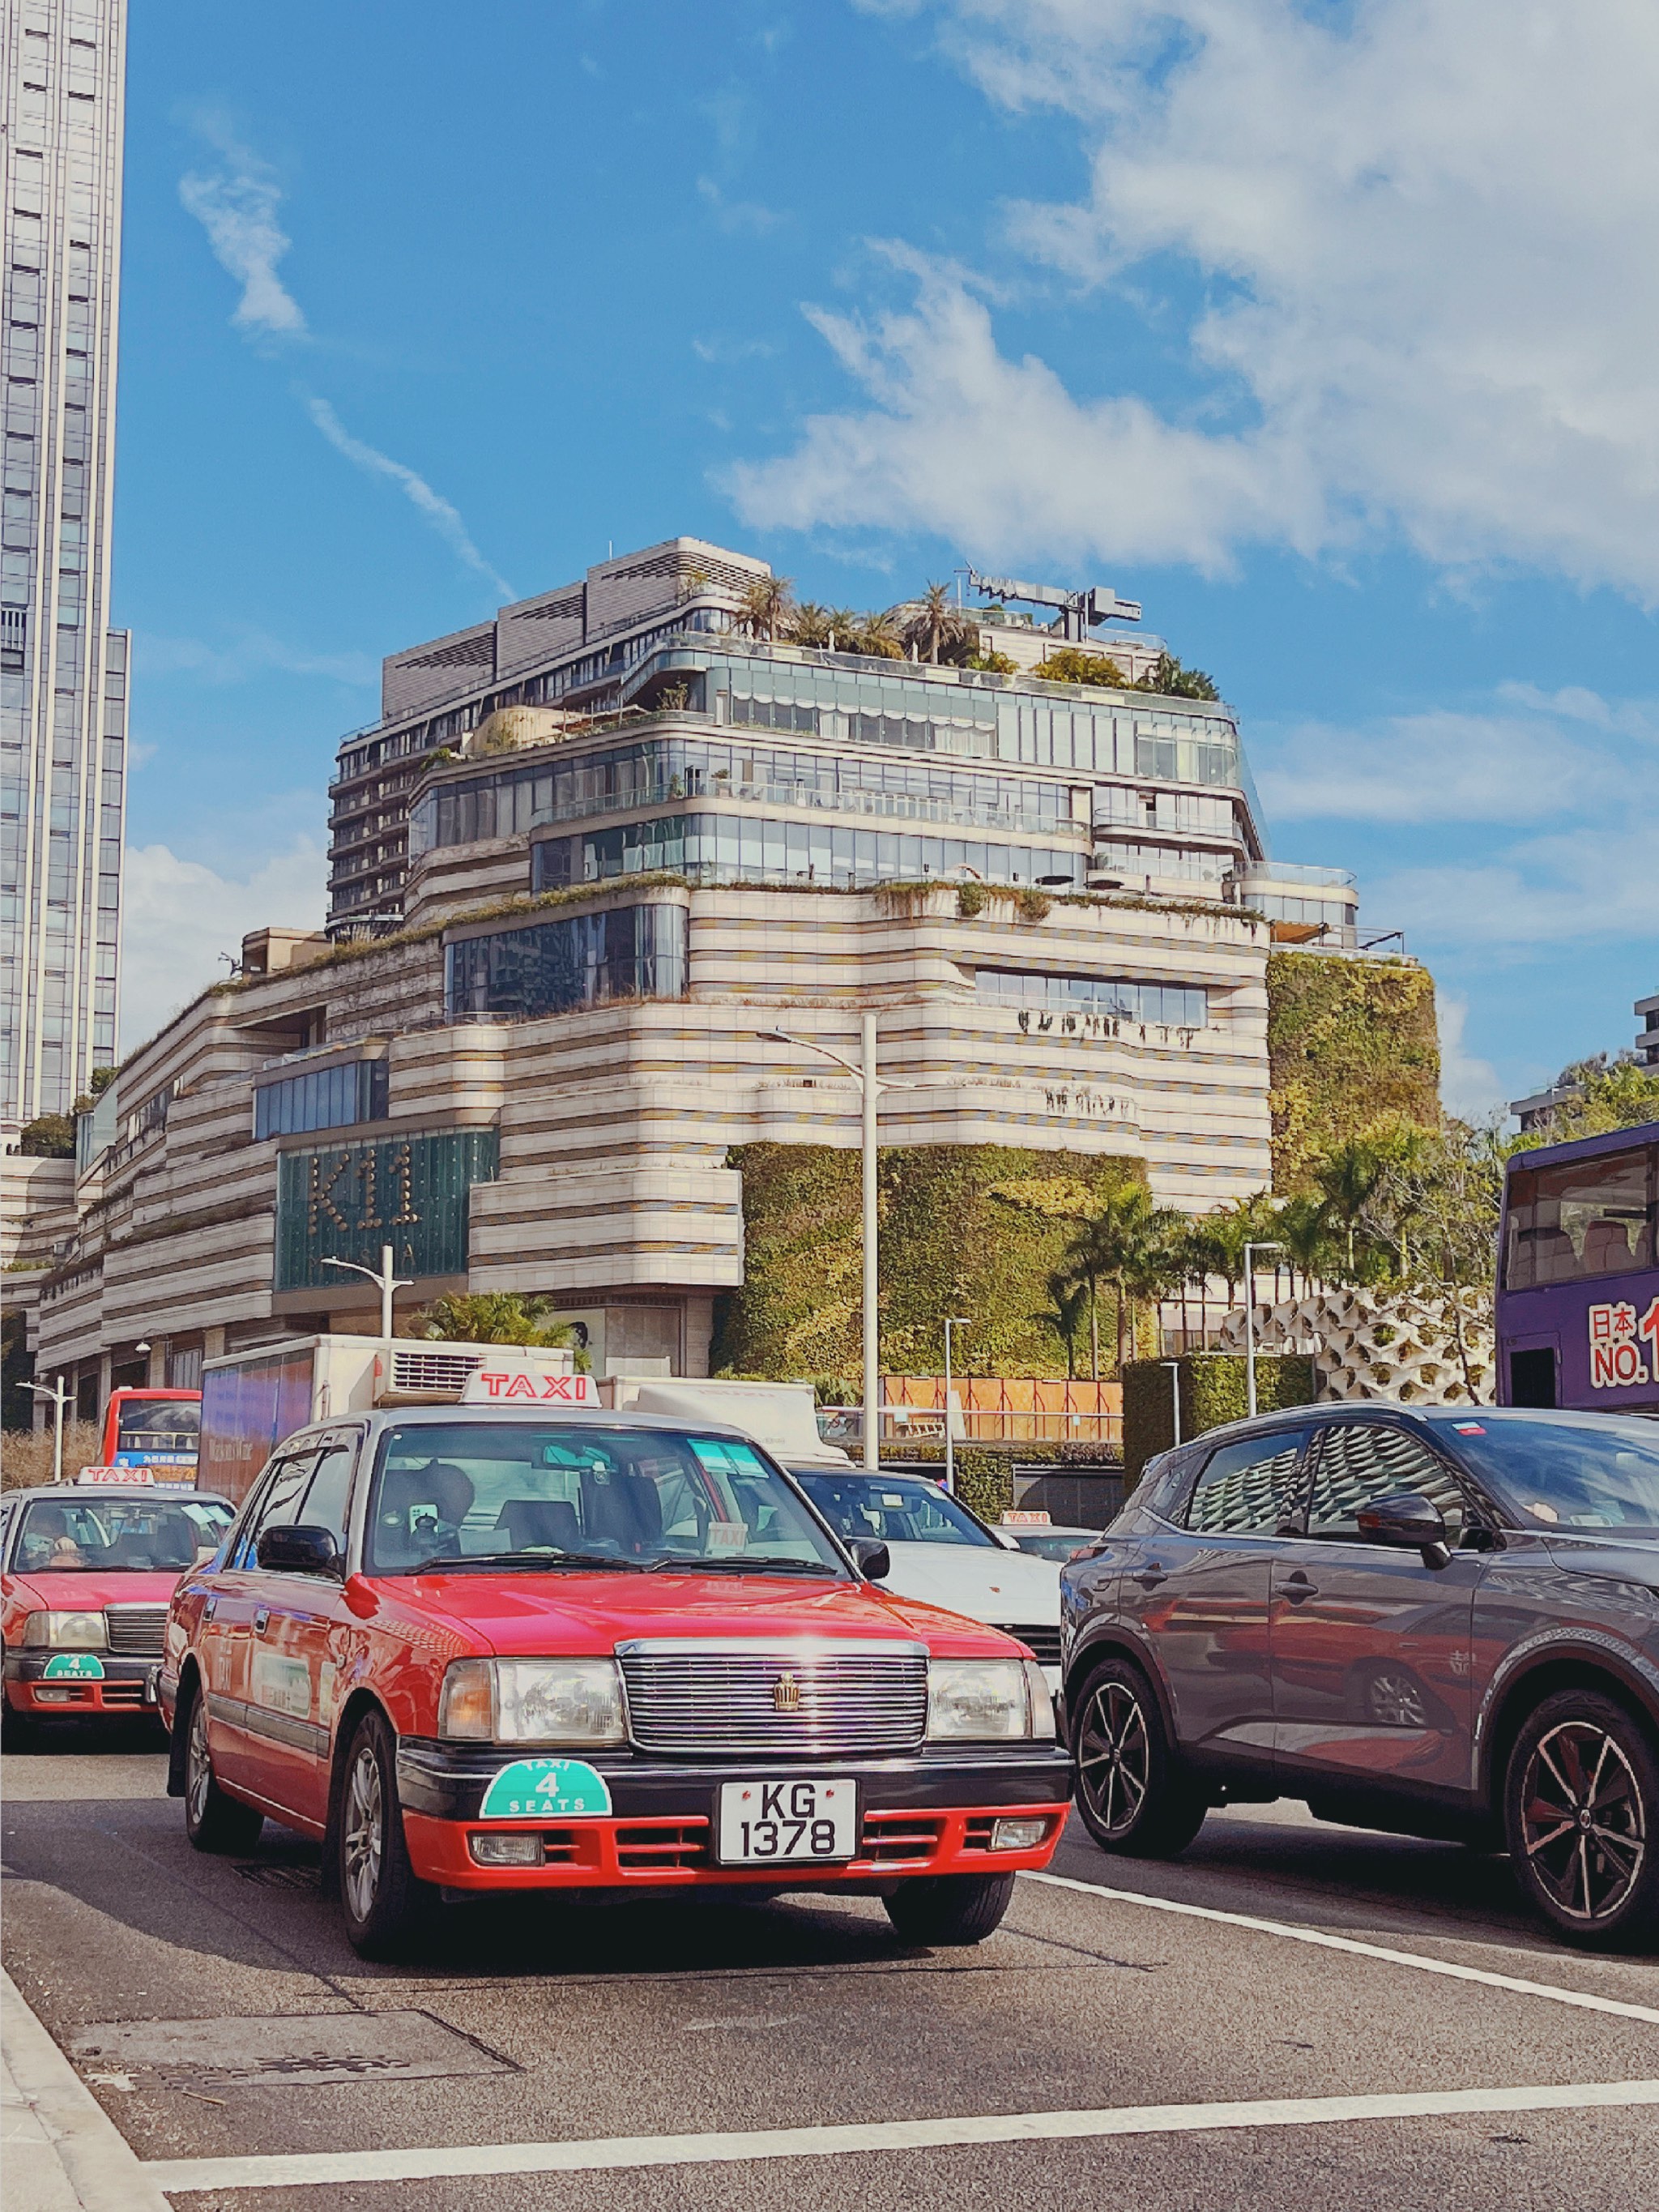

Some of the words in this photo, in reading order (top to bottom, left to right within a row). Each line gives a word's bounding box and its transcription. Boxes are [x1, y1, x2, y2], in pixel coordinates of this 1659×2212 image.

[308, 1144, 419, 1236] K11
[309, 1244, 416, 1275] MUSA
[1593, 1306, 1634, 1339] 日本
[481, 1373, 586, 1400] TAXI
[87, 1468, 147, 1482] TAXI
[1008, 1513, 1047, 1523] TAXI
[68, 1658, 80, 1670] 4
[535, 1772, 560, 1797] 4
[509, 1798, 585, 1813] SEATS
[761, 1783, 816, 1819] KG
[740, 1819, 835, 1857] 1378
